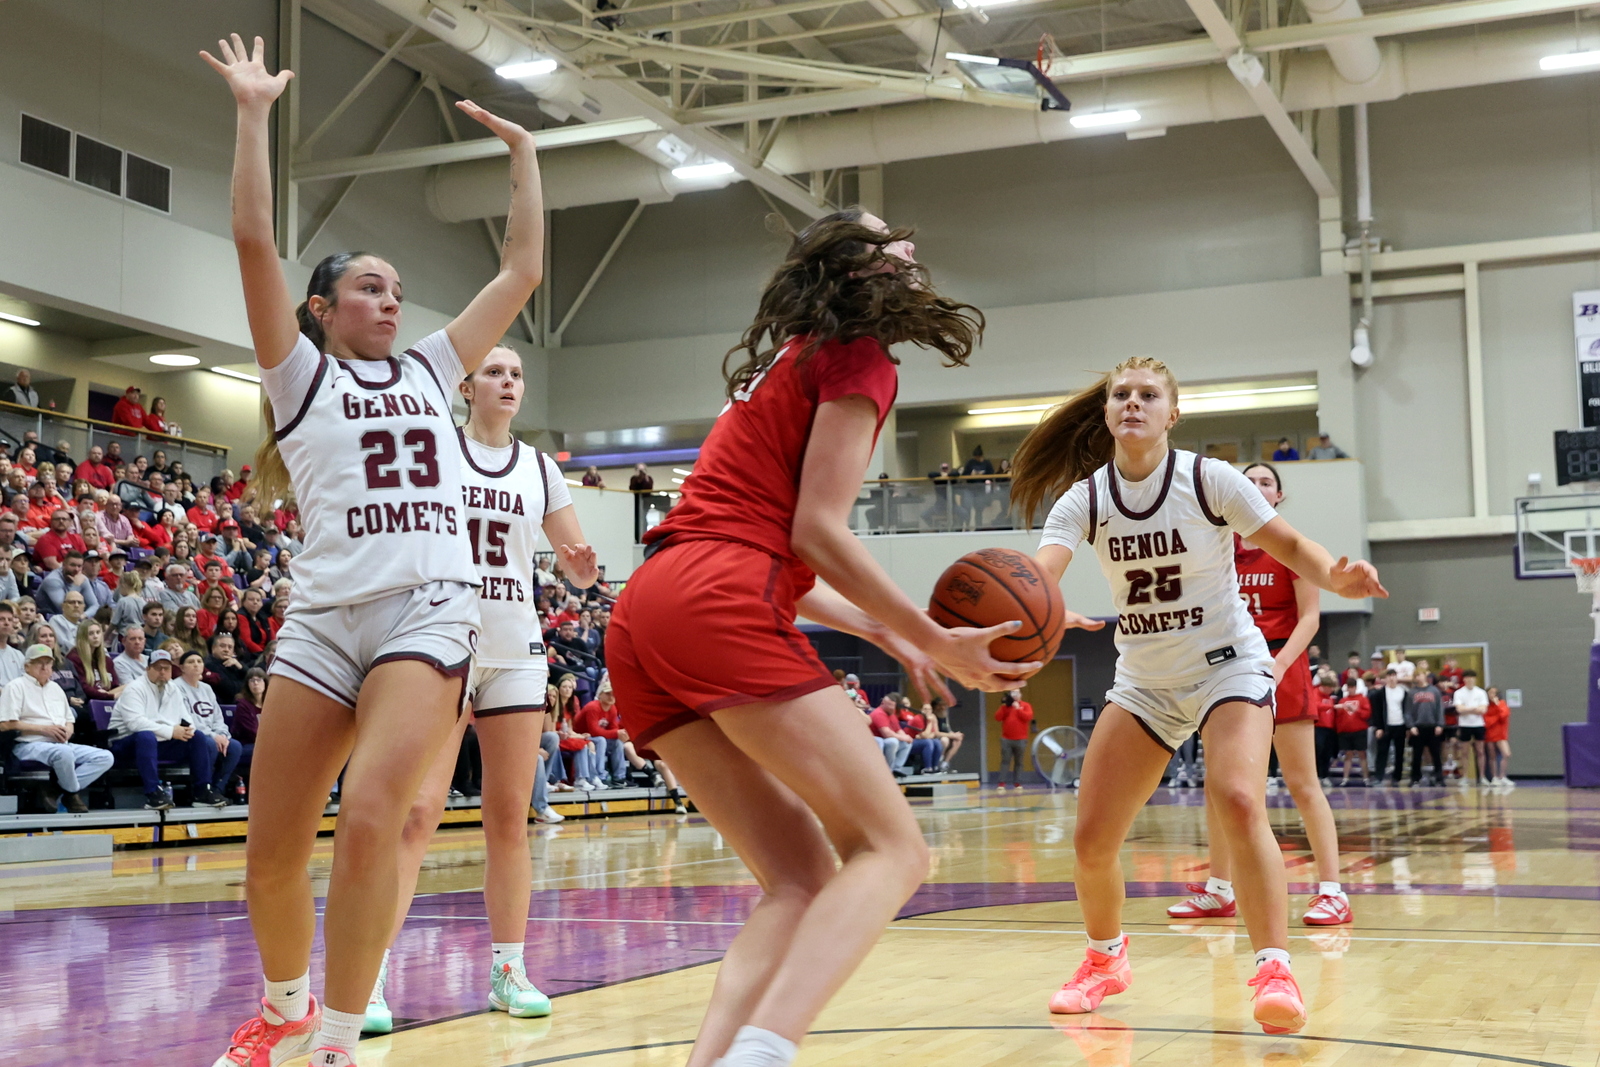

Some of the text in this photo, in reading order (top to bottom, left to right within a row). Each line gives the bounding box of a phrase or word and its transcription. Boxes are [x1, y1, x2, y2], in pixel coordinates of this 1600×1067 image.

[1576, 303, 1600, 317] B
[342, 392, 439, 420] GENOA
[359, 427, 442, 492] 23
[347, 501, 457, 539] COMETS
[467, 517, 511, 567] 15
[1108, 528, 1188, 562] GENOA
[1124, 563, 1183, 606] 25
[1117, 607, 1204, 635] COMETS
